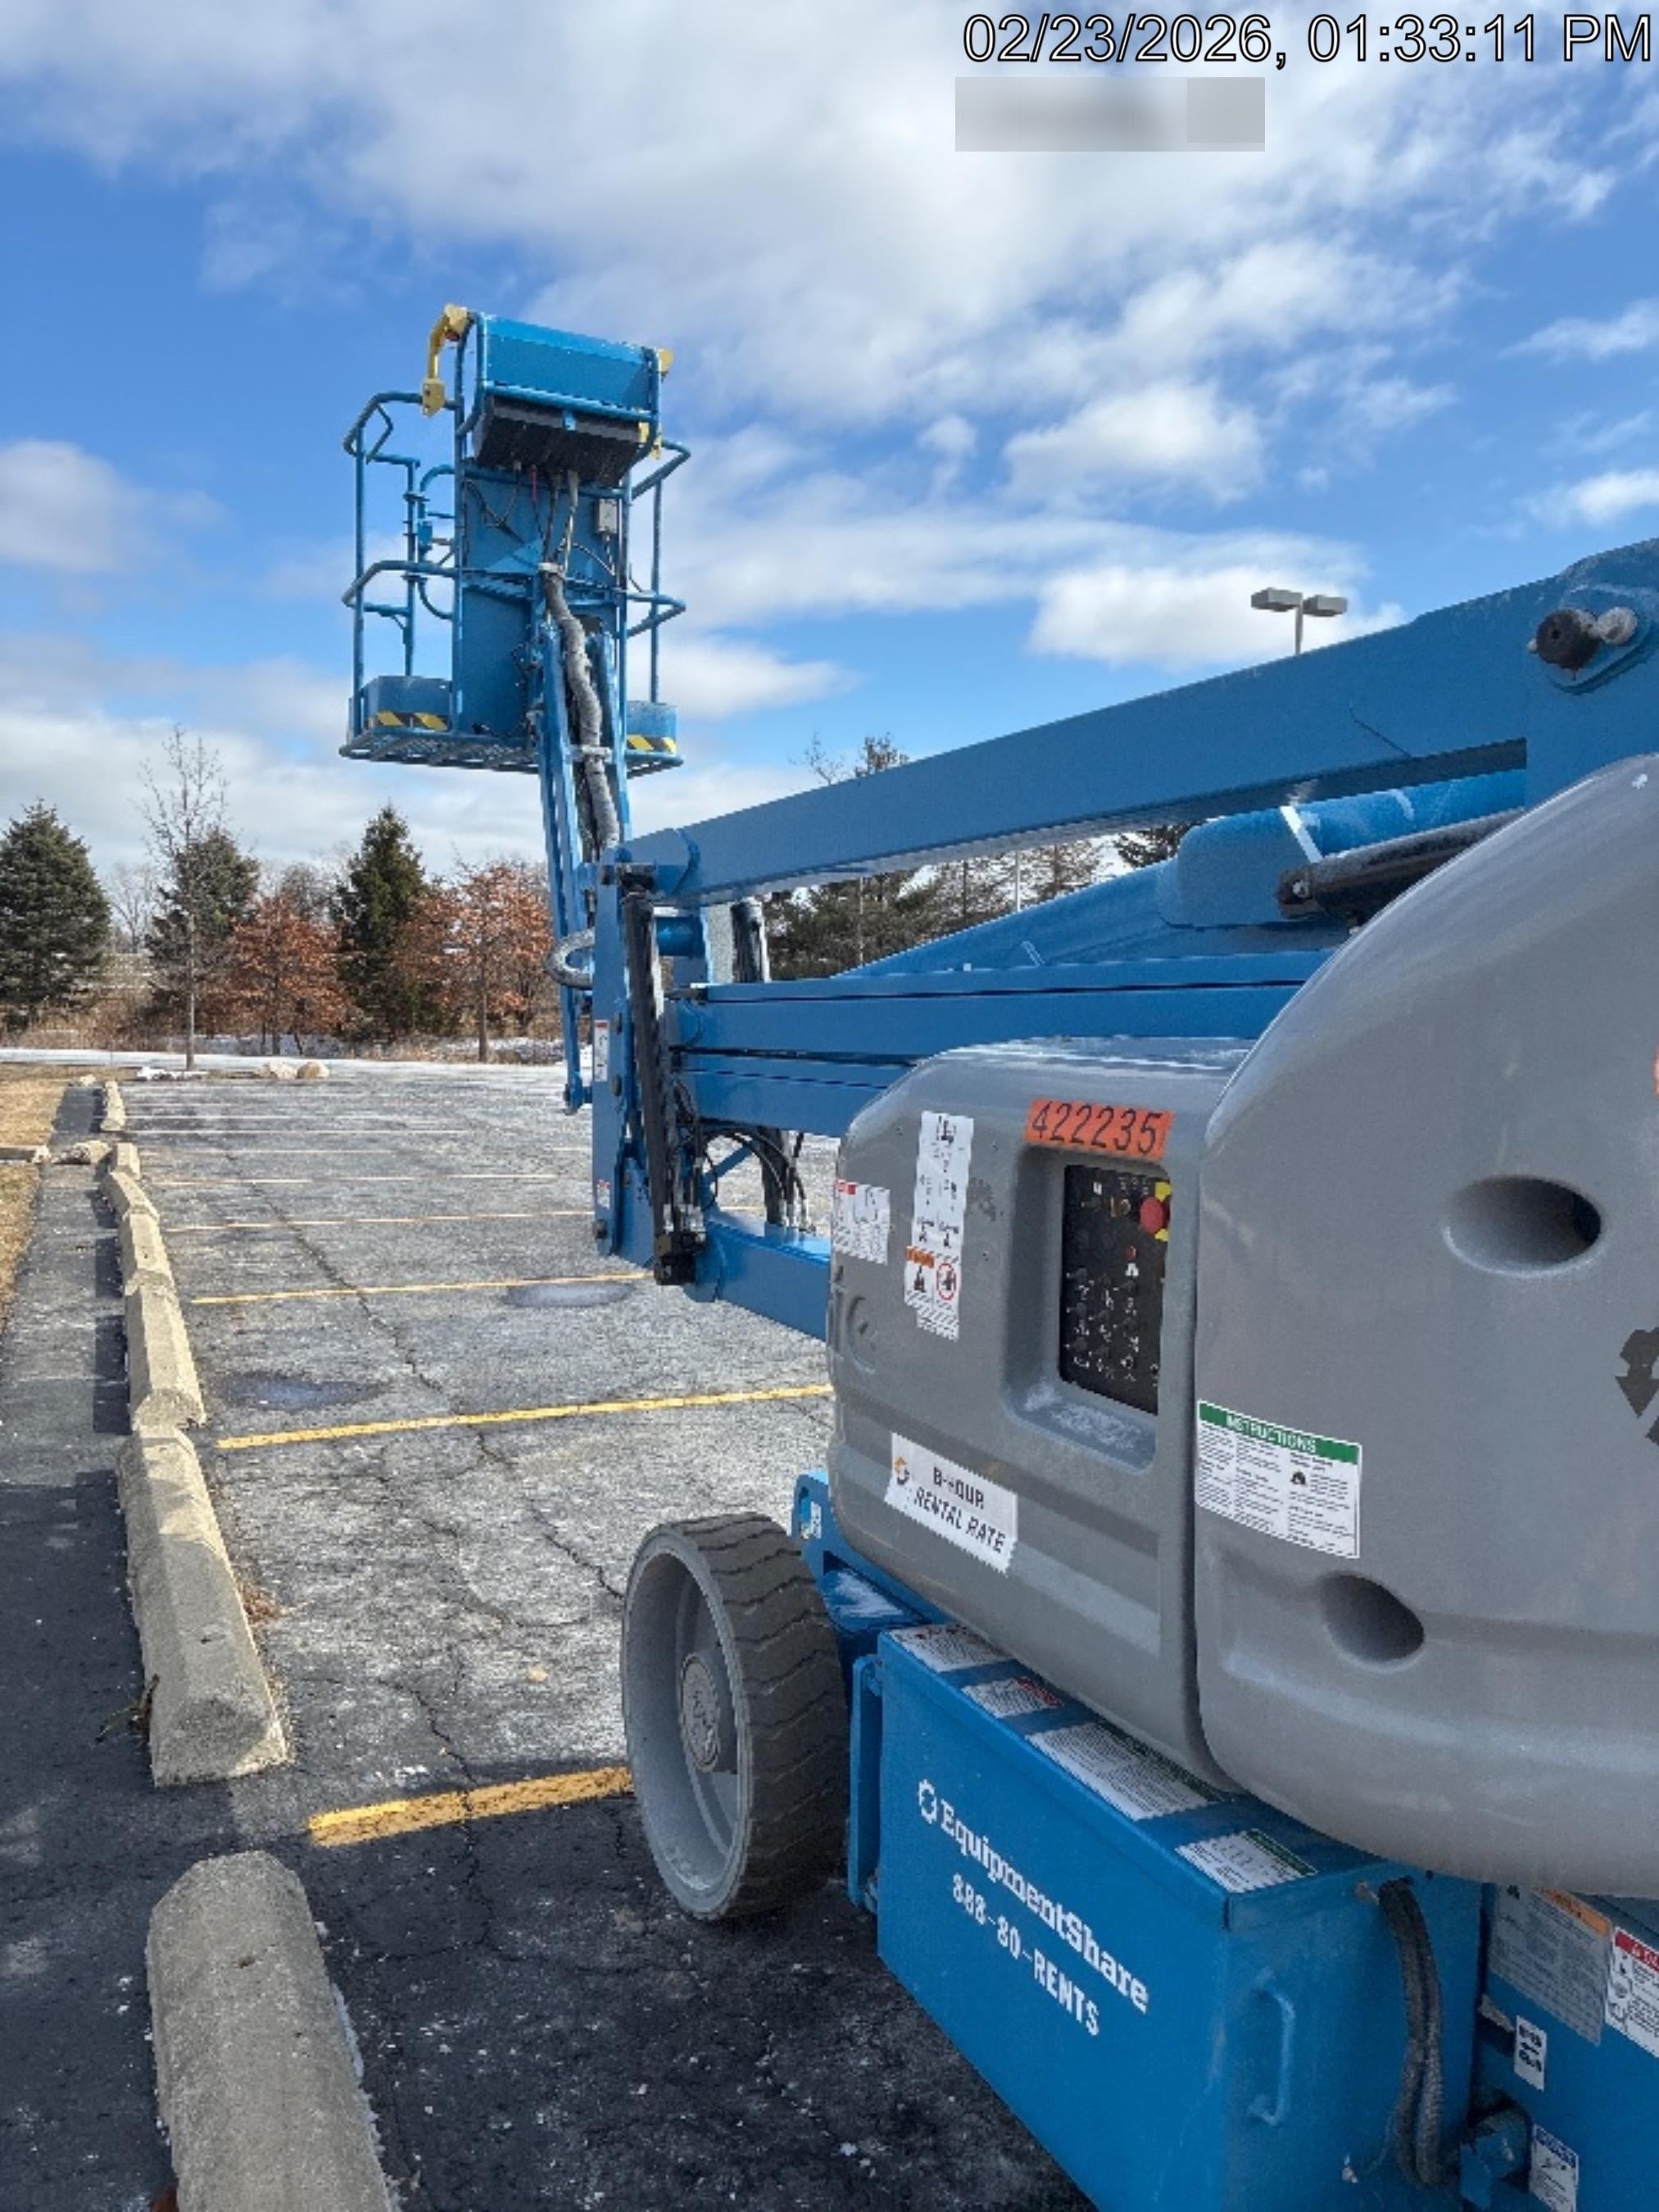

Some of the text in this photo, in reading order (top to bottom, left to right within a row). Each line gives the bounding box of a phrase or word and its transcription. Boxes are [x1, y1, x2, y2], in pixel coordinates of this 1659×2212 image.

[1032, 1100, 1163, 1154] 422235
[914, 1486, 1006, 1553] RENTAL RATE
[941, 1798, 1149, 2014] EquipmentShare
[952, 1873, 1100, 2036] 888-80-RENTS
